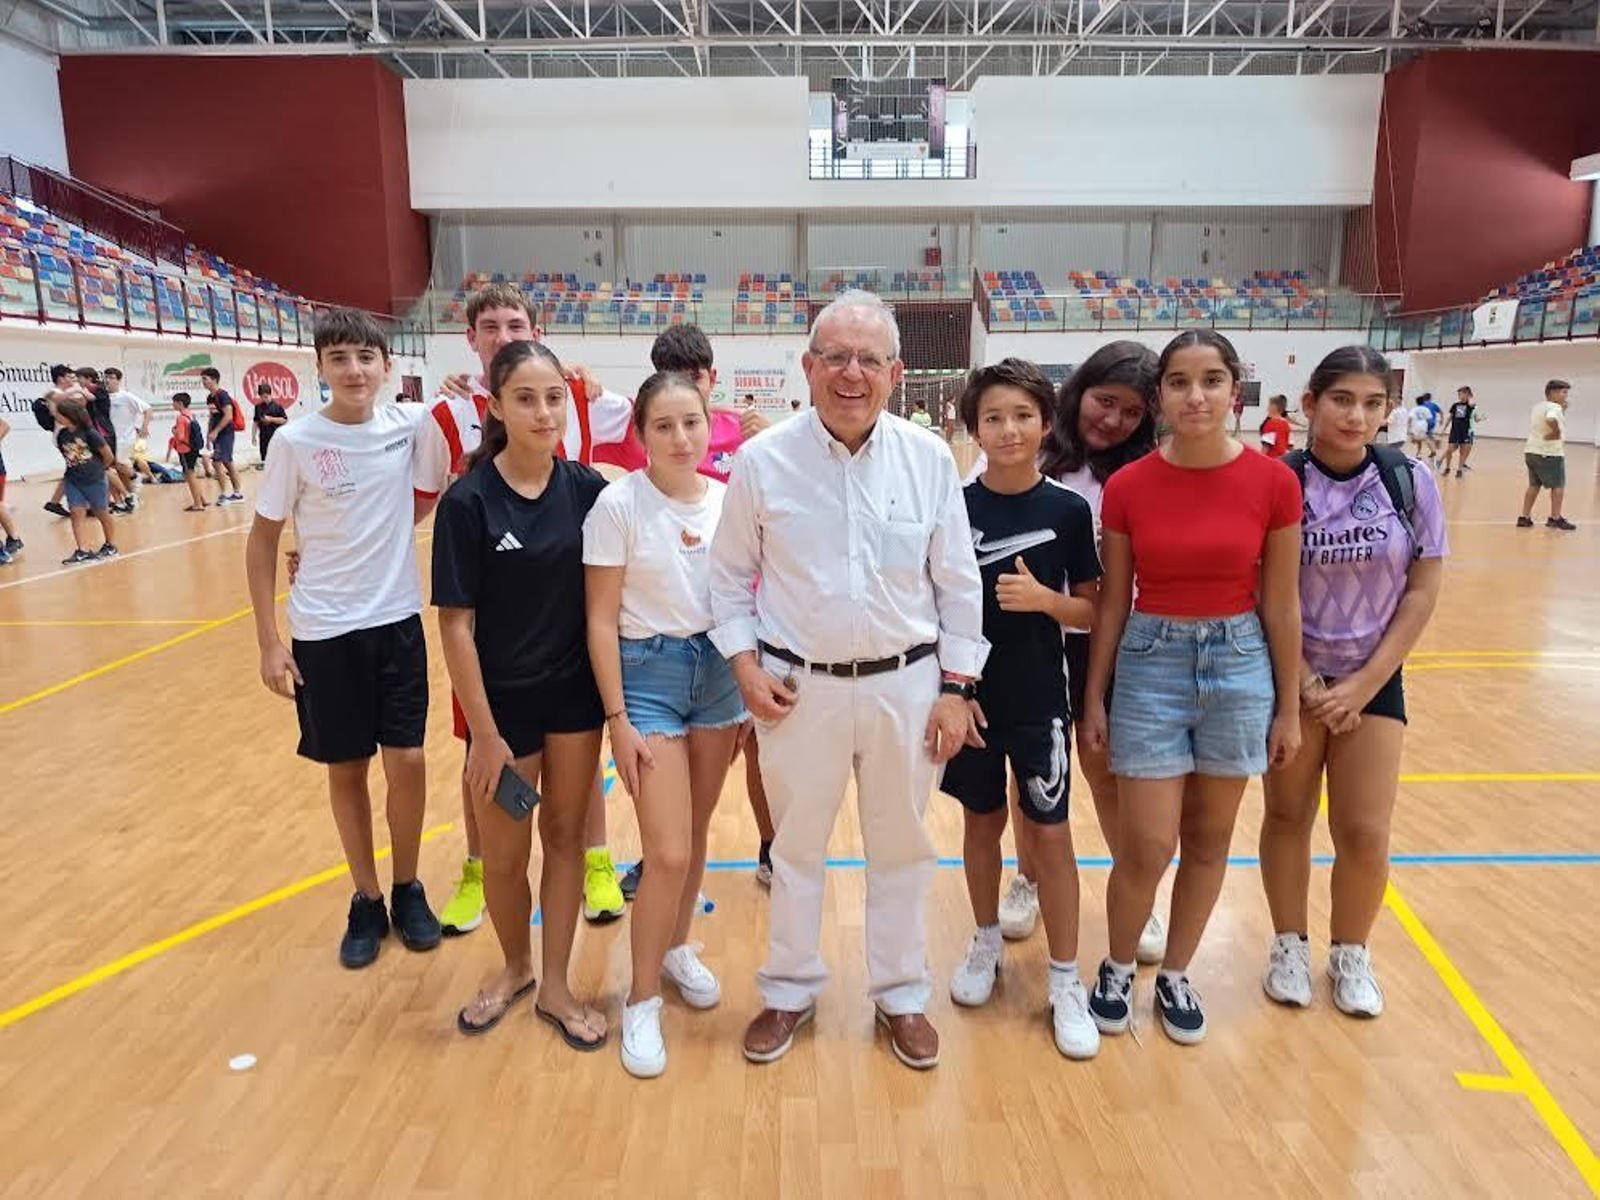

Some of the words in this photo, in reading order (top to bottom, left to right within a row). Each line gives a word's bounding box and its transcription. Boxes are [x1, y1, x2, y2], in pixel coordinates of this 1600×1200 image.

[0, 361, 51, 382] Smurfi
[0, 391, 33, 412] Alm
[1301, 525, 1388, 546] mirates
[1301, 550, 1316, 566] LY
[1321, 546, 1373, 566] BETTER
